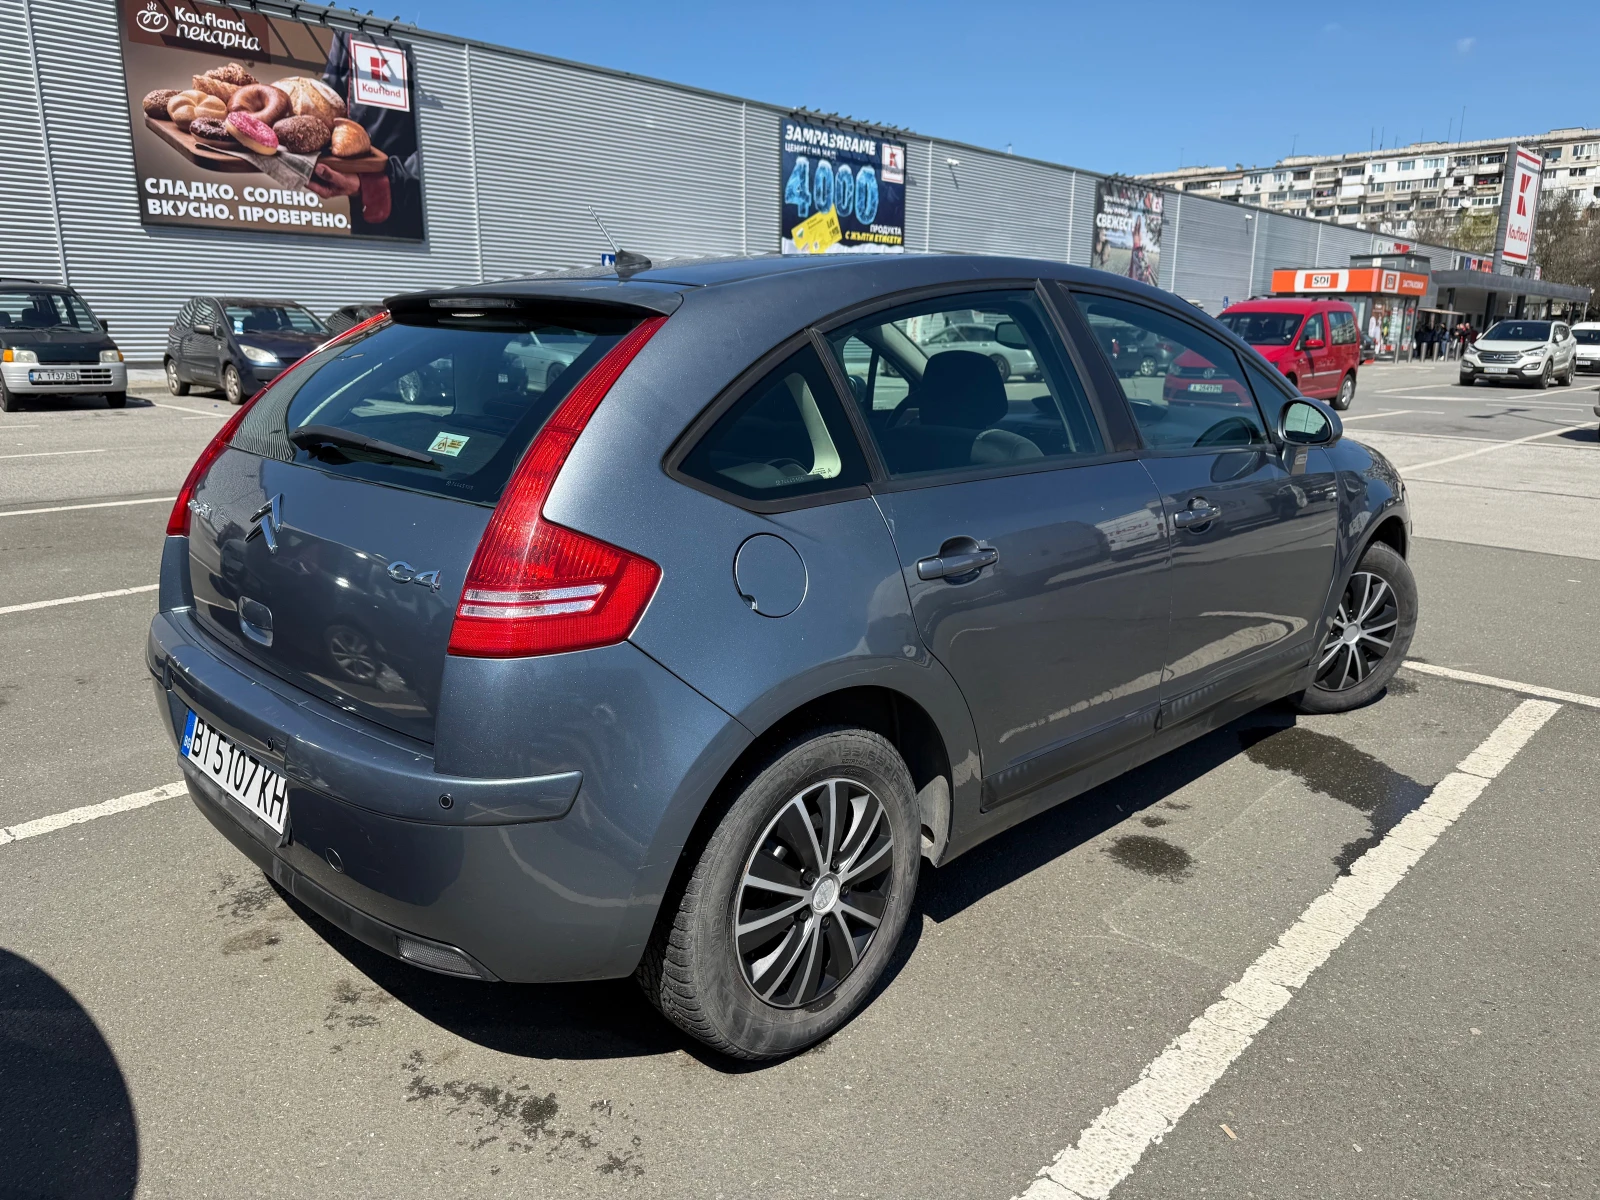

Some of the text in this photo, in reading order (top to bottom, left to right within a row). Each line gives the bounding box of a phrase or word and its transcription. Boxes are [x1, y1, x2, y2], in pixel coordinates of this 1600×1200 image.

[174, 6, 246, 33] Kaufland
[176, 24, 261, 51] пекарна
[362, 83, 402, 99] Kaufland
[785, 125, 876, 155] ЗАМРАЗЯВАМЕ
[144, 177, 323, 208] СЛАДКО. СОЛЕНО.
[784, 156, 879, 225] 4000
[147, 199, 352, 229] ВКУСНО. ПРОВЕРЕНО.
[870, 225, 902, 235] ПРОДУКТА
[1508, 223, 1529, 243] Kaufland
[1313, 276, 1330, 285] SDI
[387, 560, 441, 593] C4
[183, 735, 192, 749] BG
[191, 717, 287, 824] BT 5107 KH
